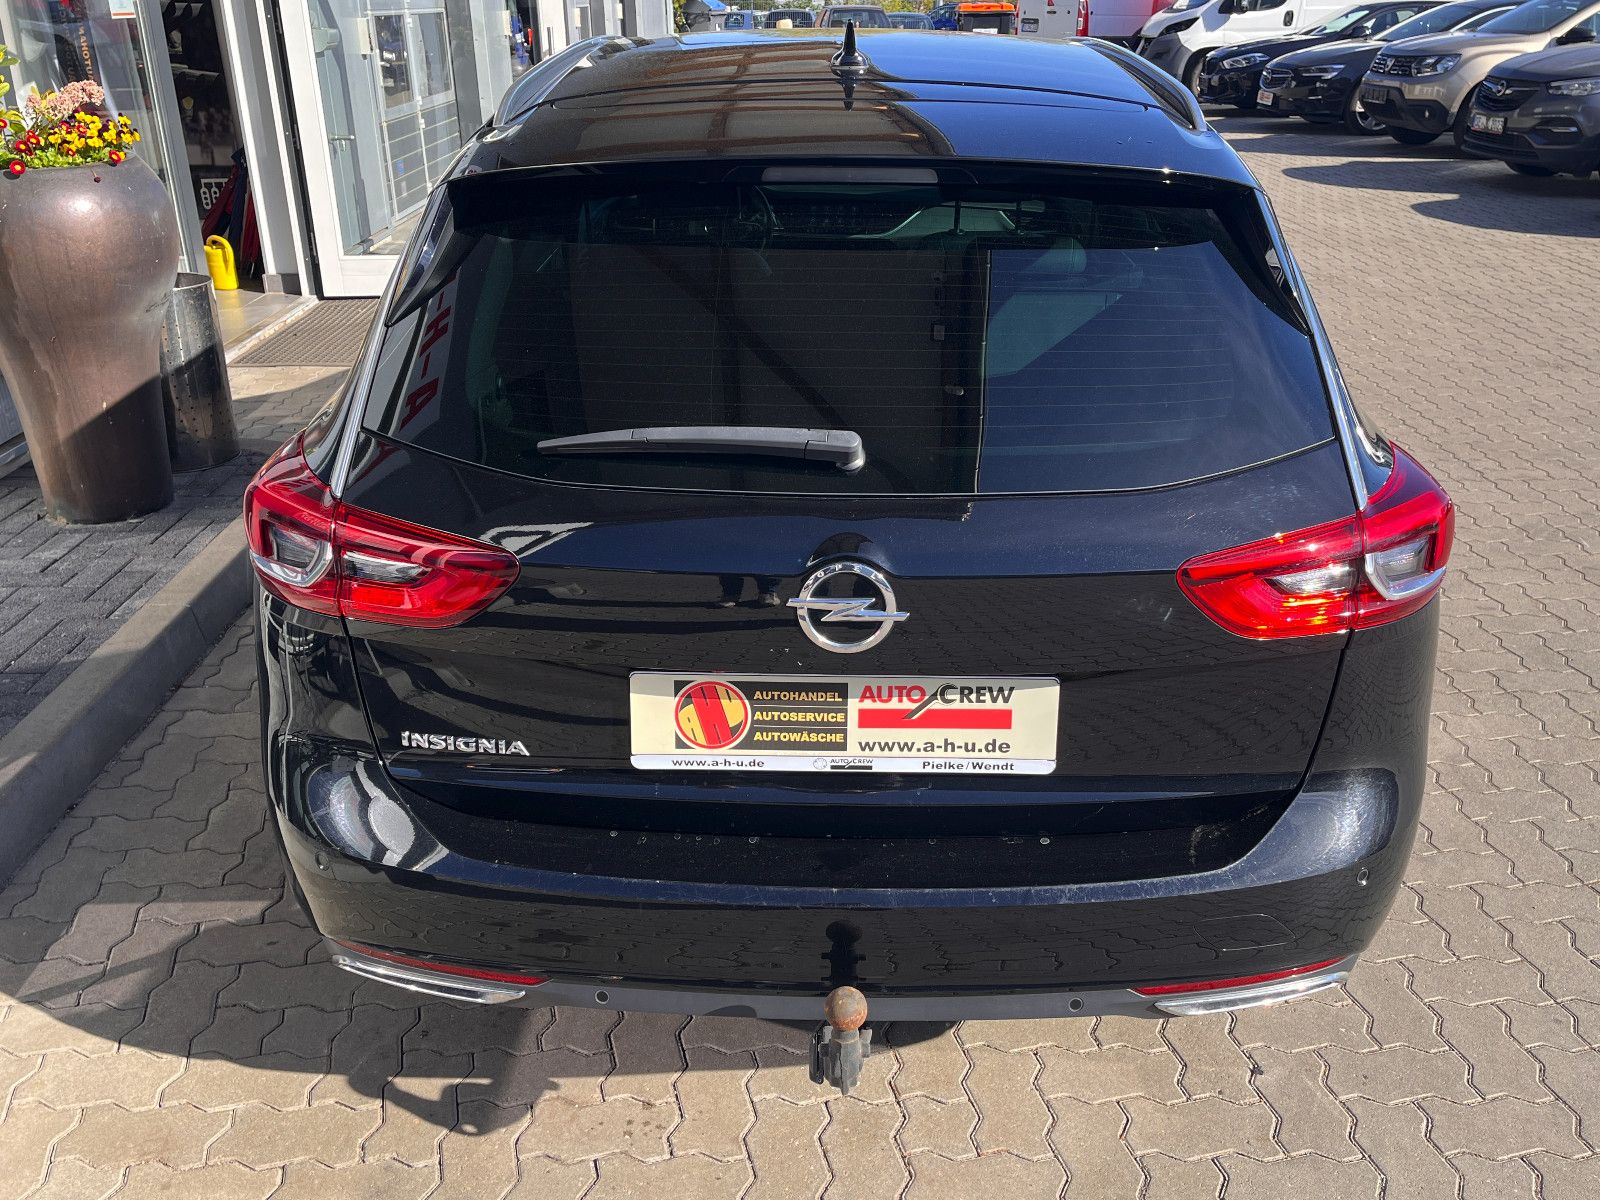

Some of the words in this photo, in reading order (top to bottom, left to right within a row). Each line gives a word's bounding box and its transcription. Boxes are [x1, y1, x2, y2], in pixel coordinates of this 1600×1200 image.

[753, 690, 843, 702] AUTOHANDEL
[858, 684, 926, 704] AUTO
[937, 683, 1015, 704] CREW
[753, 711, 846, 723] AUTOSERVICE
[753, 730, 845, 743] AUTOWÄSCHE
[400, 730, 530, 756] INSIGNIA
[858, 739, 1012, 754] www.a-h-u.de
[671, 758, 765, 768] www.a-h-u.de
[922, 760, 1015, 771] Pielke/Wendt
